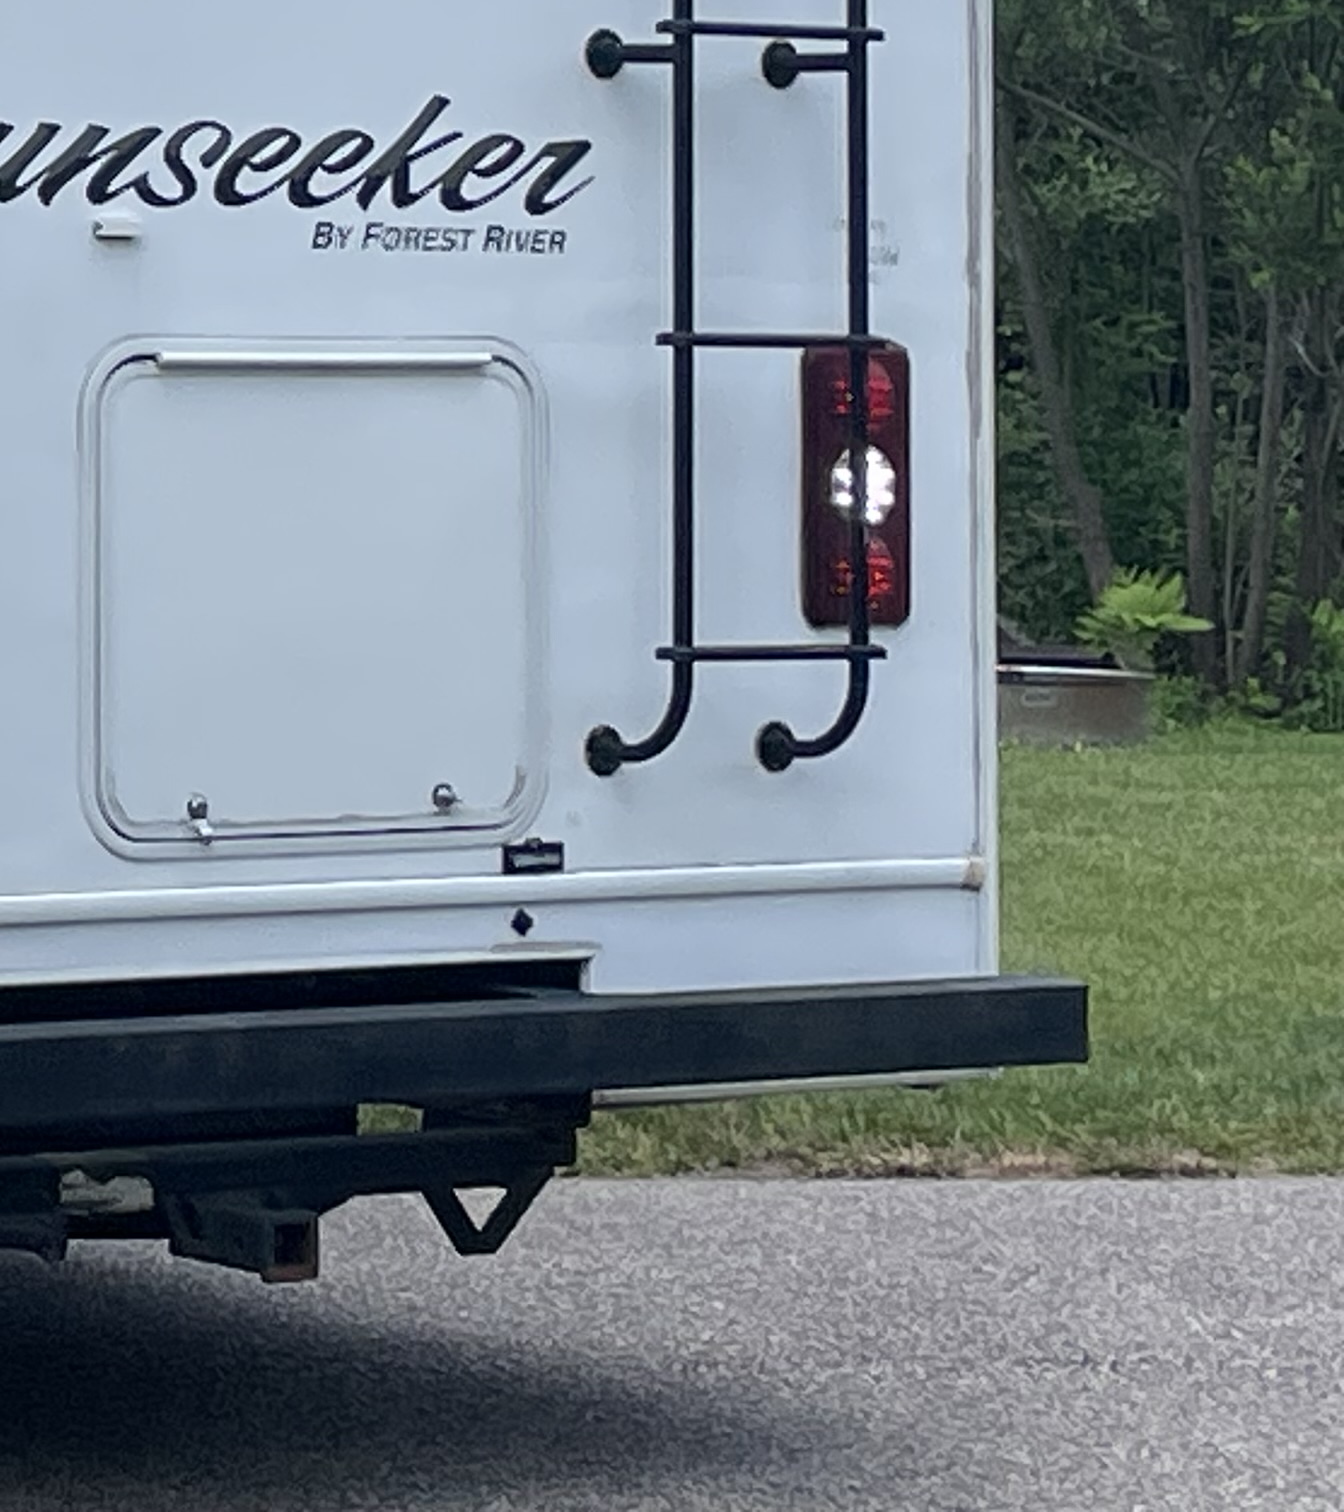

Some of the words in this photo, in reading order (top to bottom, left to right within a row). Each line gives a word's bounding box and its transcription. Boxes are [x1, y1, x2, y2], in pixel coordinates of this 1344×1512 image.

[311, 221, 354, 251] BY
[360, 221, 476, 254] FOREST
[481, 224, 568, 255] RIVER
